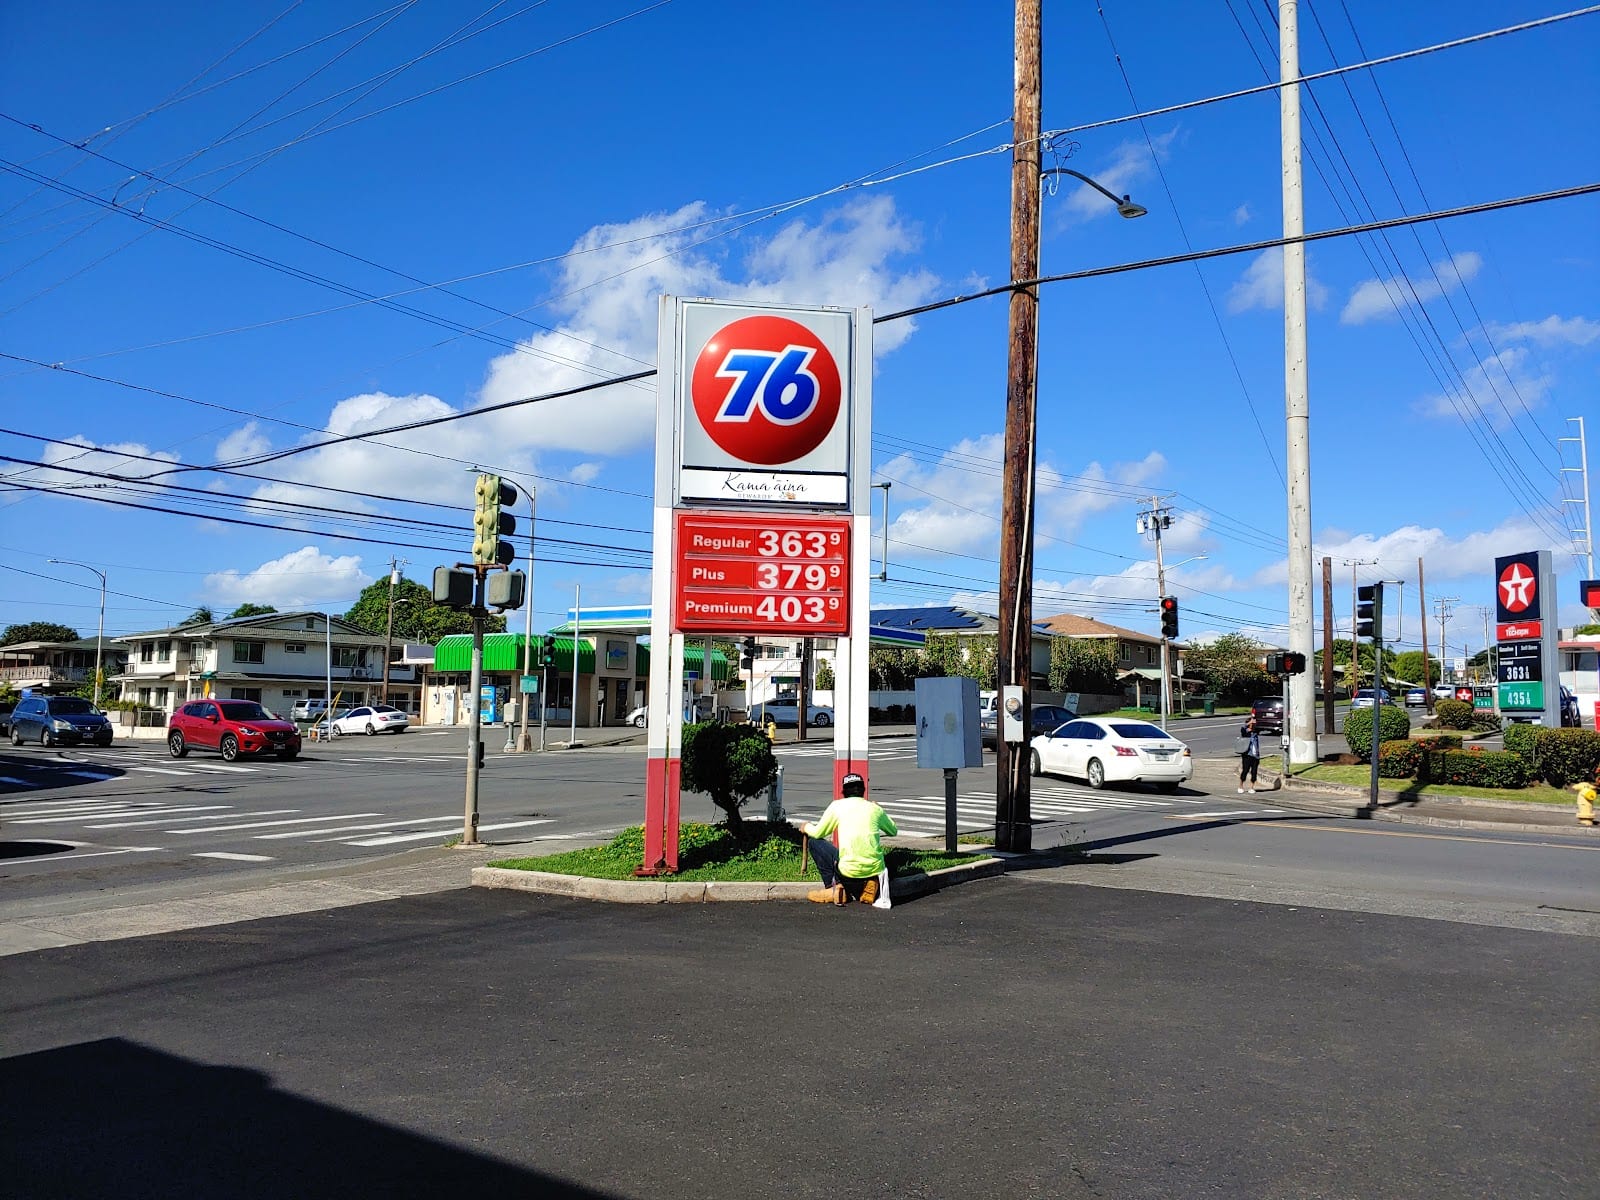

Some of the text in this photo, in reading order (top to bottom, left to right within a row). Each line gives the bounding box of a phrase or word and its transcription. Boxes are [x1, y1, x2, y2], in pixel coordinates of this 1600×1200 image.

[714, 345, 820, 426] 76
[693, 530, 841, 558] Regular 363 9
[692, 563, 841, 589] Plus 379 9
[685, 596, 840, 622] Premium 403 9
[1506, 666, 1525, 680] 363
